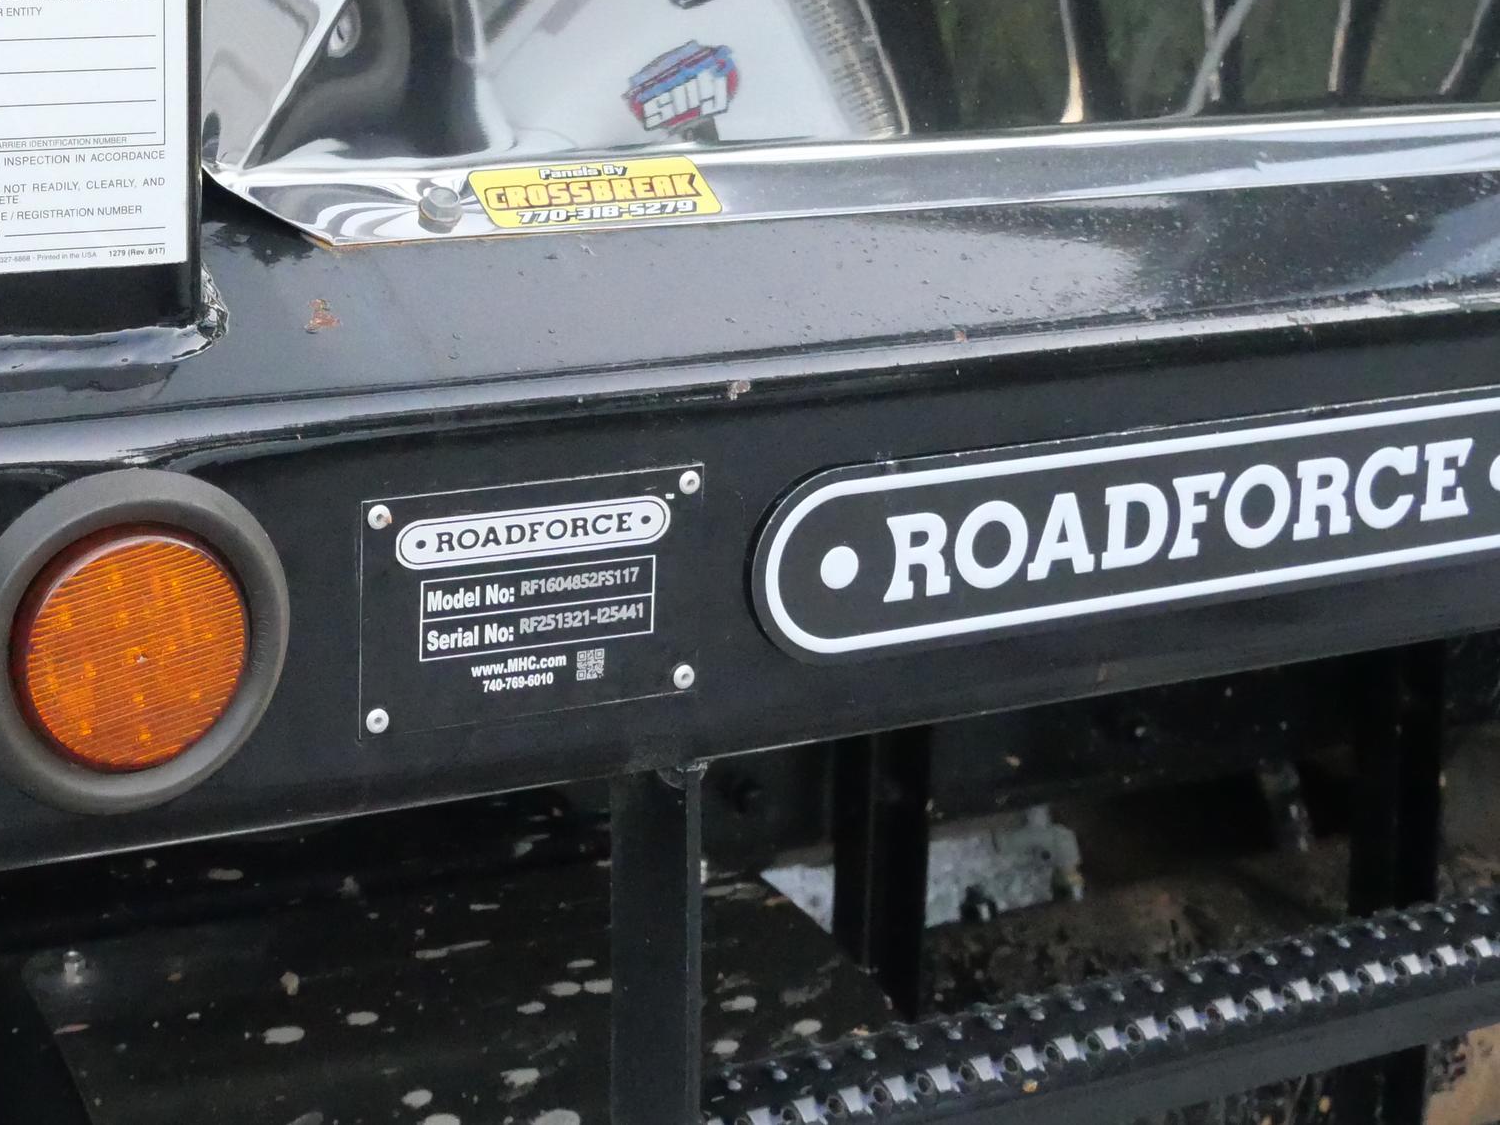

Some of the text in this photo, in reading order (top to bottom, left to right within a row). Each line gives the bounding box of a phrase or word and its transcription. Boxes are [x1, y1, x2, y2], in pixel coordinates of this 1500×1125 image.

[6, 6, 42, 17] ENTITY
[29, 138, 91, 148] IDENTIFICATION
[92, 136, 127, 145] NUMBER
[4, 155, 70, 166] INSPECTION
[75, 154, 86, 163] IN
[90, 150, 165, 162] ACCORDANCE
[540, 163, 628, 180] Panels By
[3, 183, 27, 194] NOT
[142, 177, 165, 187] AND
[484, 173, 702, 210] CROSSBREAK
[16, 208, 94, 220] REGISTRATION
[97, 205, 142, 216] NUMBER
[517, 200, 697, 224] 770-318-5279
[36, 253, 60, 261] Printed
[109, 249, 126, 257] 1279
[883, 437, 1474, 604] ROADFORCE
[435, 511, 633, 553] ROADFORCE
[426, 567, 640, 613] Model No: RF1604852FS117
[426, 625, 480, 652] Serial
[484, 623, 515, 645] No:
[471, 653, 567, 678] www.MHC.com
[482, 672, 554, 694] 740-769-6010
